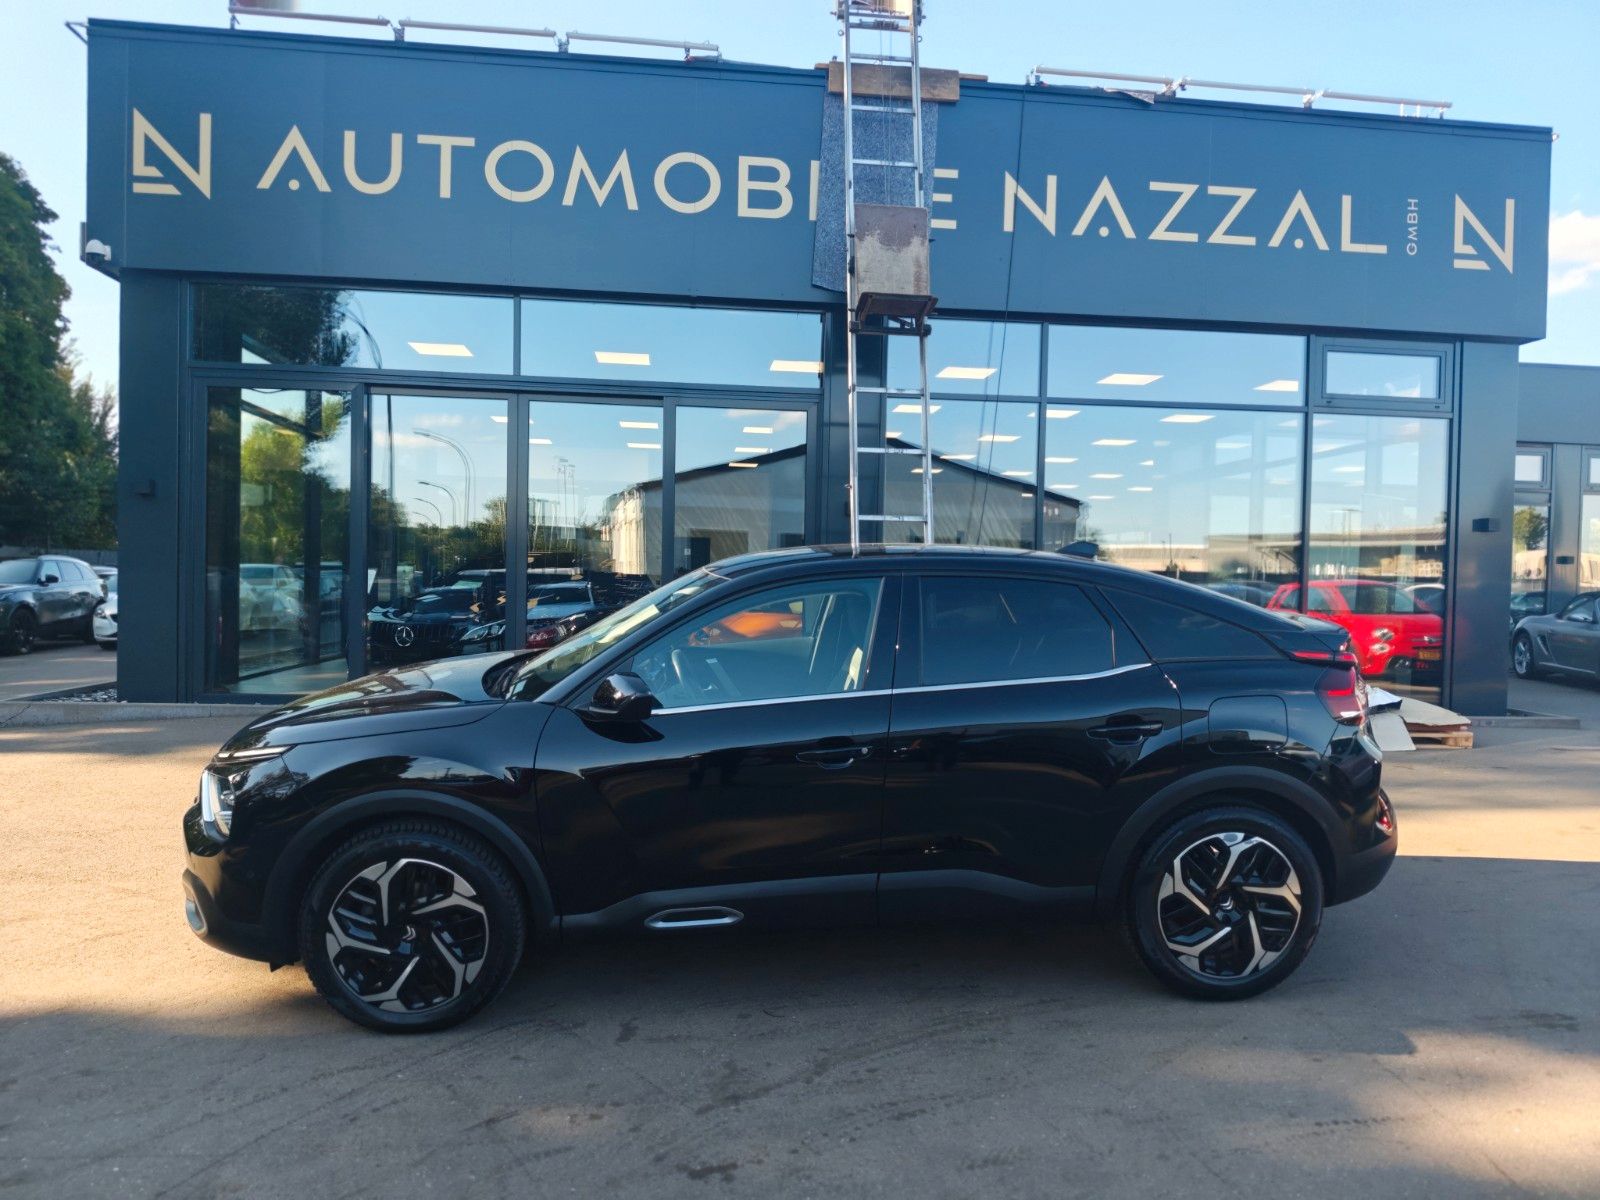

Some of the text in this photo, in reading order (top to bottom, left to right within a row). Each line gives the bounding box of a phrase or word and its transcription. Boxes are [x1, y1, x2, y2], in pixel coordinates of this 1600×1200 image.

[256, 124, 1388, 254] AUTOMOBIE NAZZAL
[1406, 199, 1419, 256] GMBH
